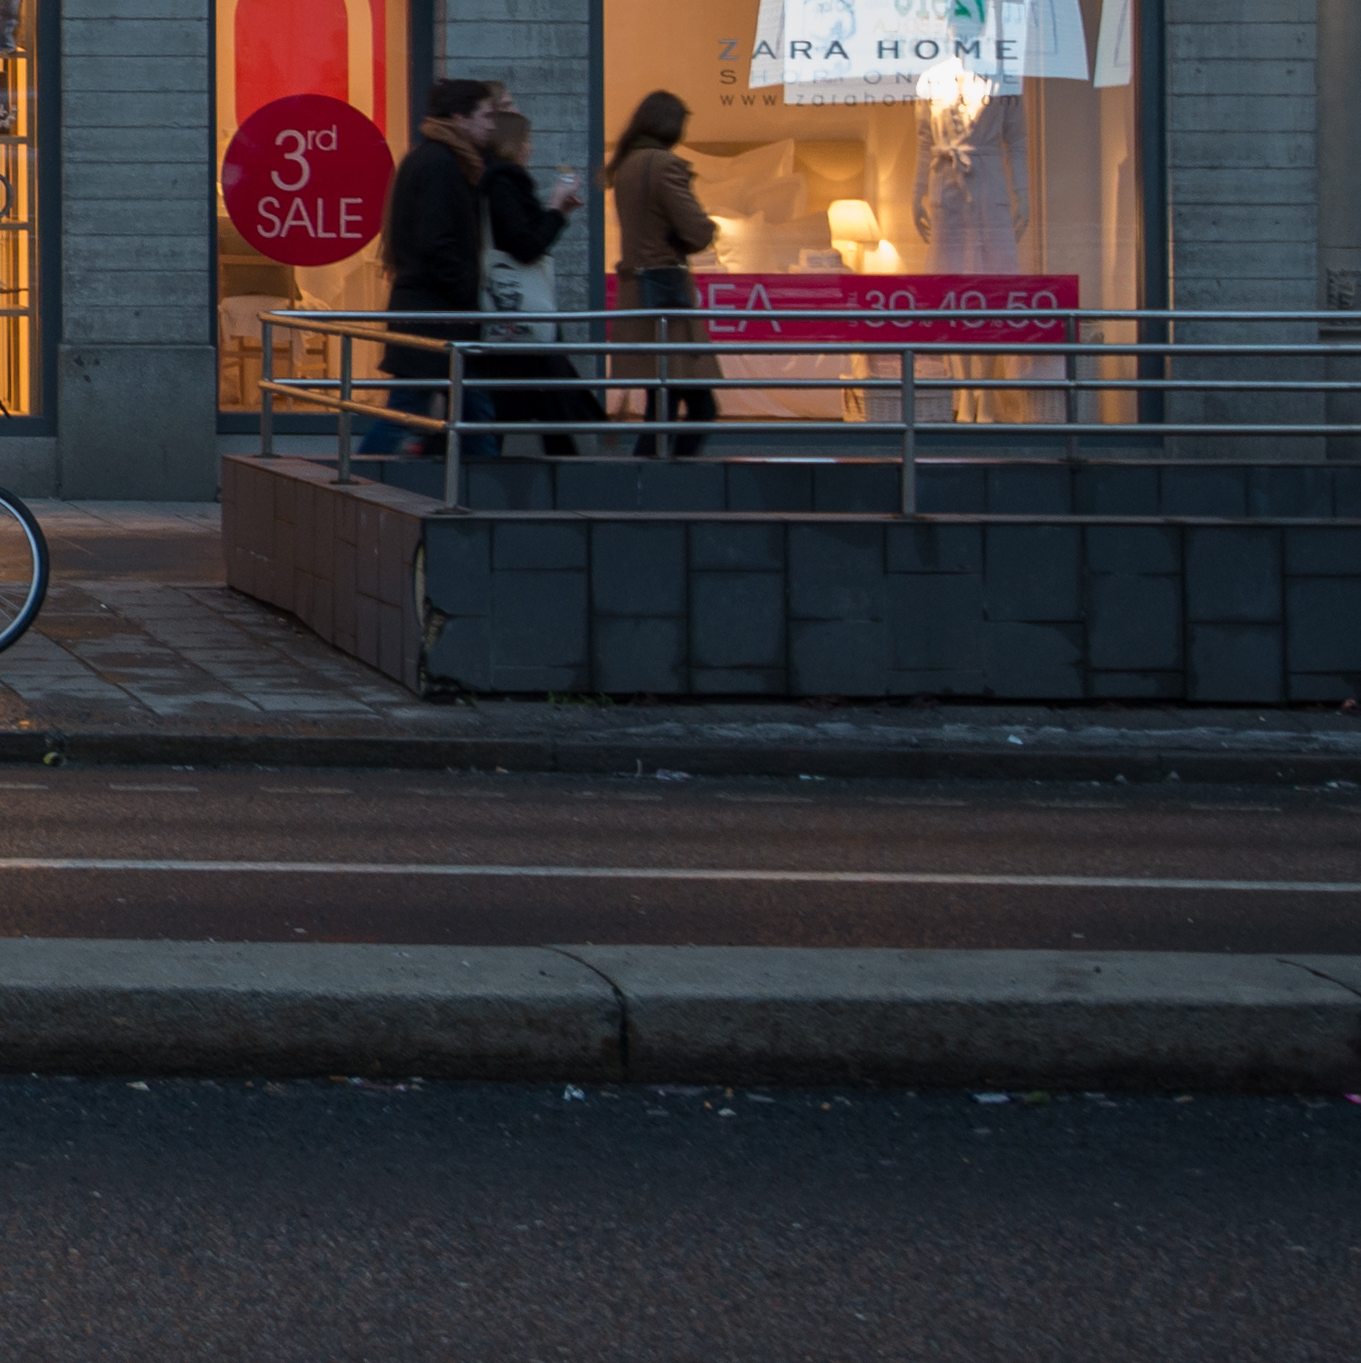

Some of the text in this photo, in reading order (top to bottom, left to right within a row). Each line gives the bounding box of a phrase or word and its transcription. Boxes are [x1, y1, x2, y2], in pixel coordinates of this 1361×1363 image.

[718, 39, 1019, 61] ZARA HOME
[863, 68, 1019, 85] ONNE
[270, 124, 338, 192] 3rd
[256, 195, 364, 239] SALE
[695, 282, 782, 333] EA
